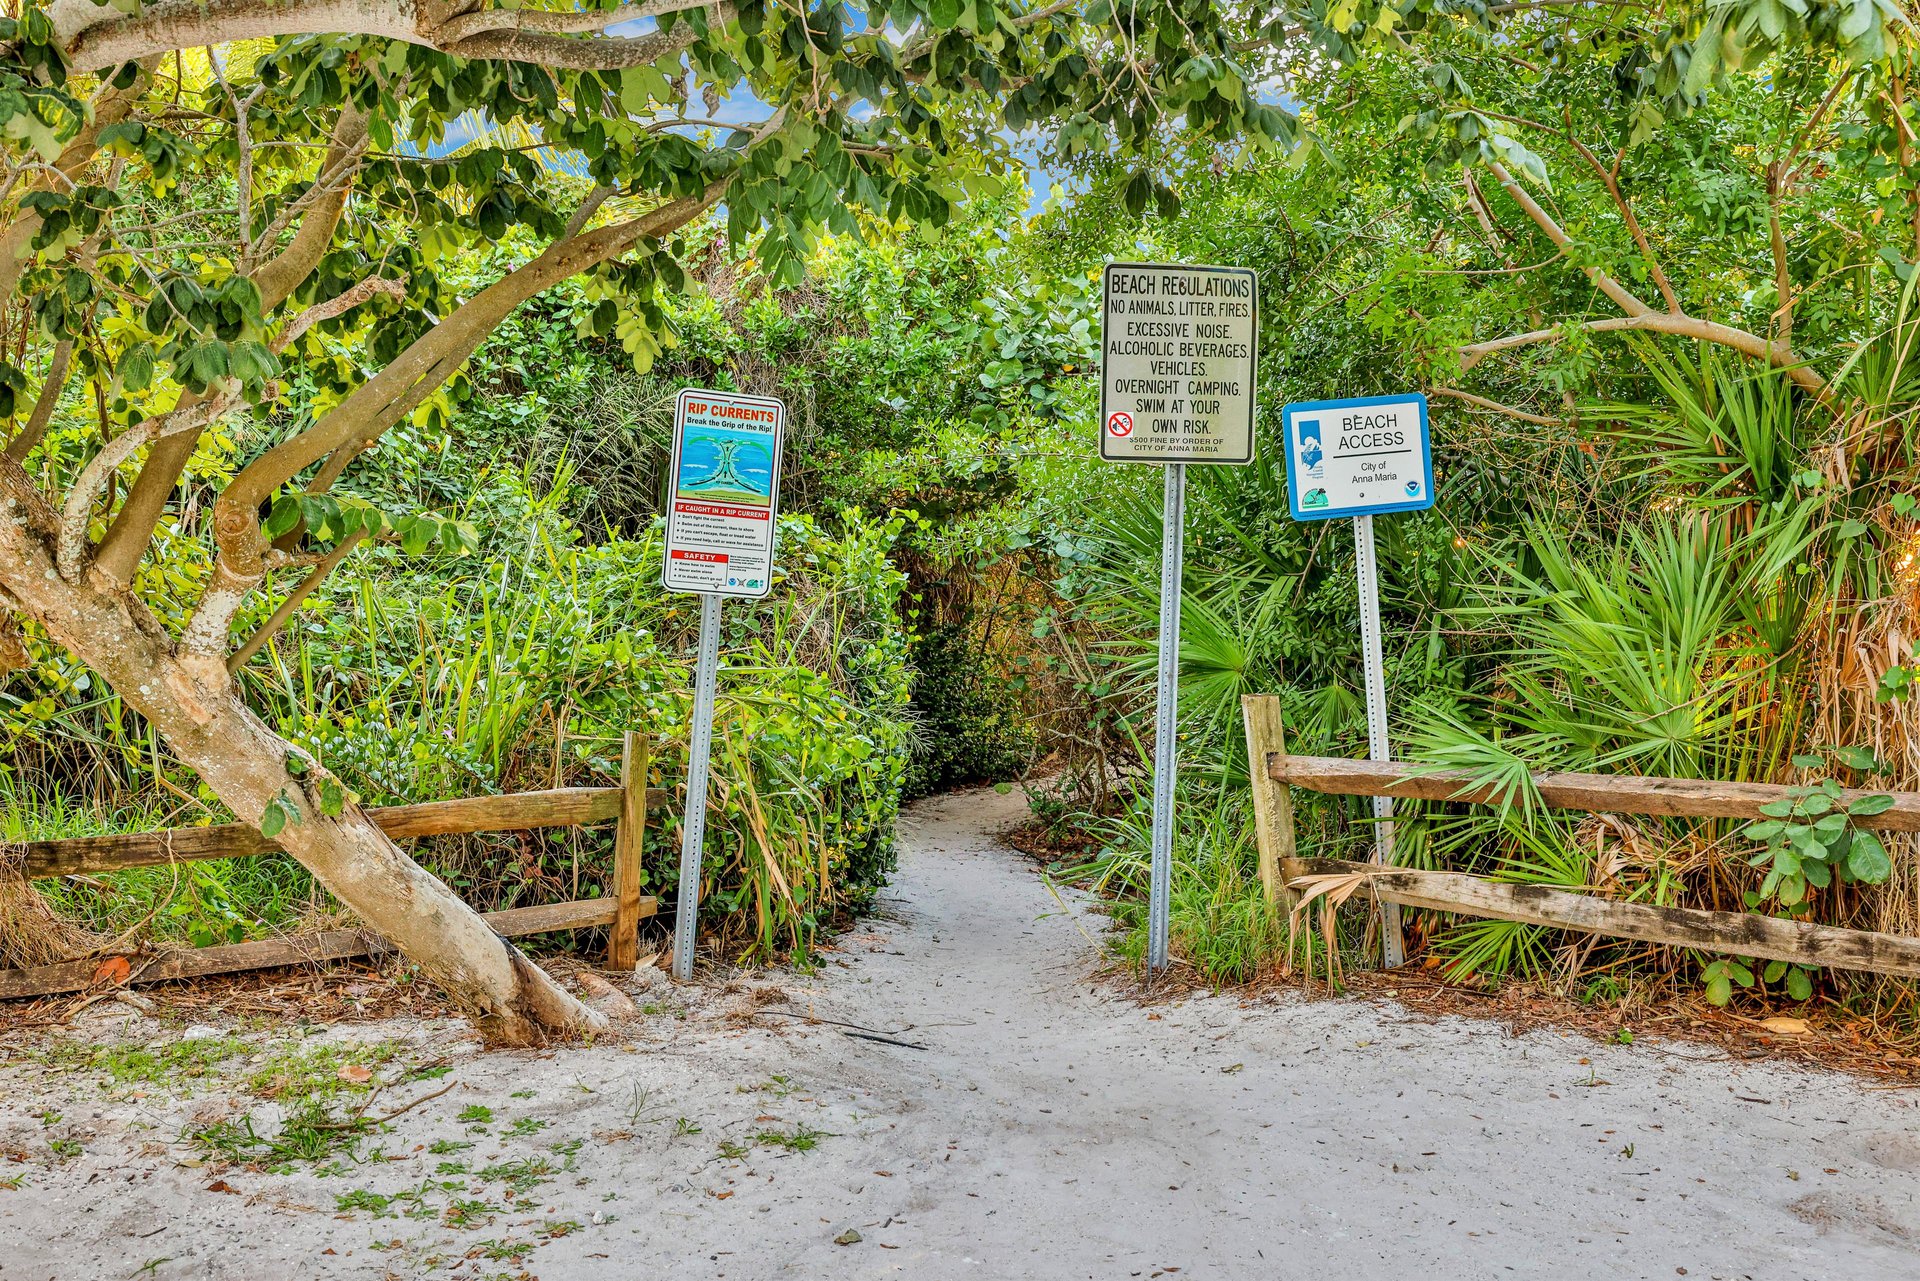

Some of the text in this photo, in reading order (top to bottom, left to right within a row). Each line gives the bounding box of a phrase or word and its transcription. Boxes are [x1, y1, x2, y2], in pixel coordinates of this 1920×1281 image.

[1112, 275, 1249, 297] BEACH REGULATIONS
[1111, 300, 1250, 318] NO ANIMALS, LITTER, FIRES.
[1127, 322, 1232, 339] EXCESSIVE NOISE.
[1110, 342, 1249, 358] ALCOHOLIC BEVERAGES.
[1150, 361, 1207, 376] VEHICLES.
[1115, 379, 1240, 396] OVERNIGHT CAMPING.
[688, 402, 774, 422] RIP CURRENTS
[1136, 400, 1220, 414] SWIM AT YOUR
[722, 421, 735, 429] Grip
[1152, 419, 1211, 434] OWN RISK.
[1342, 414, 1397, 431] BEACH
[1339, 432, 1404, 450] ACCESS
[1361, 461, 1386, 472] City of
[1352, 472, 1397, 484] Anna Maria
